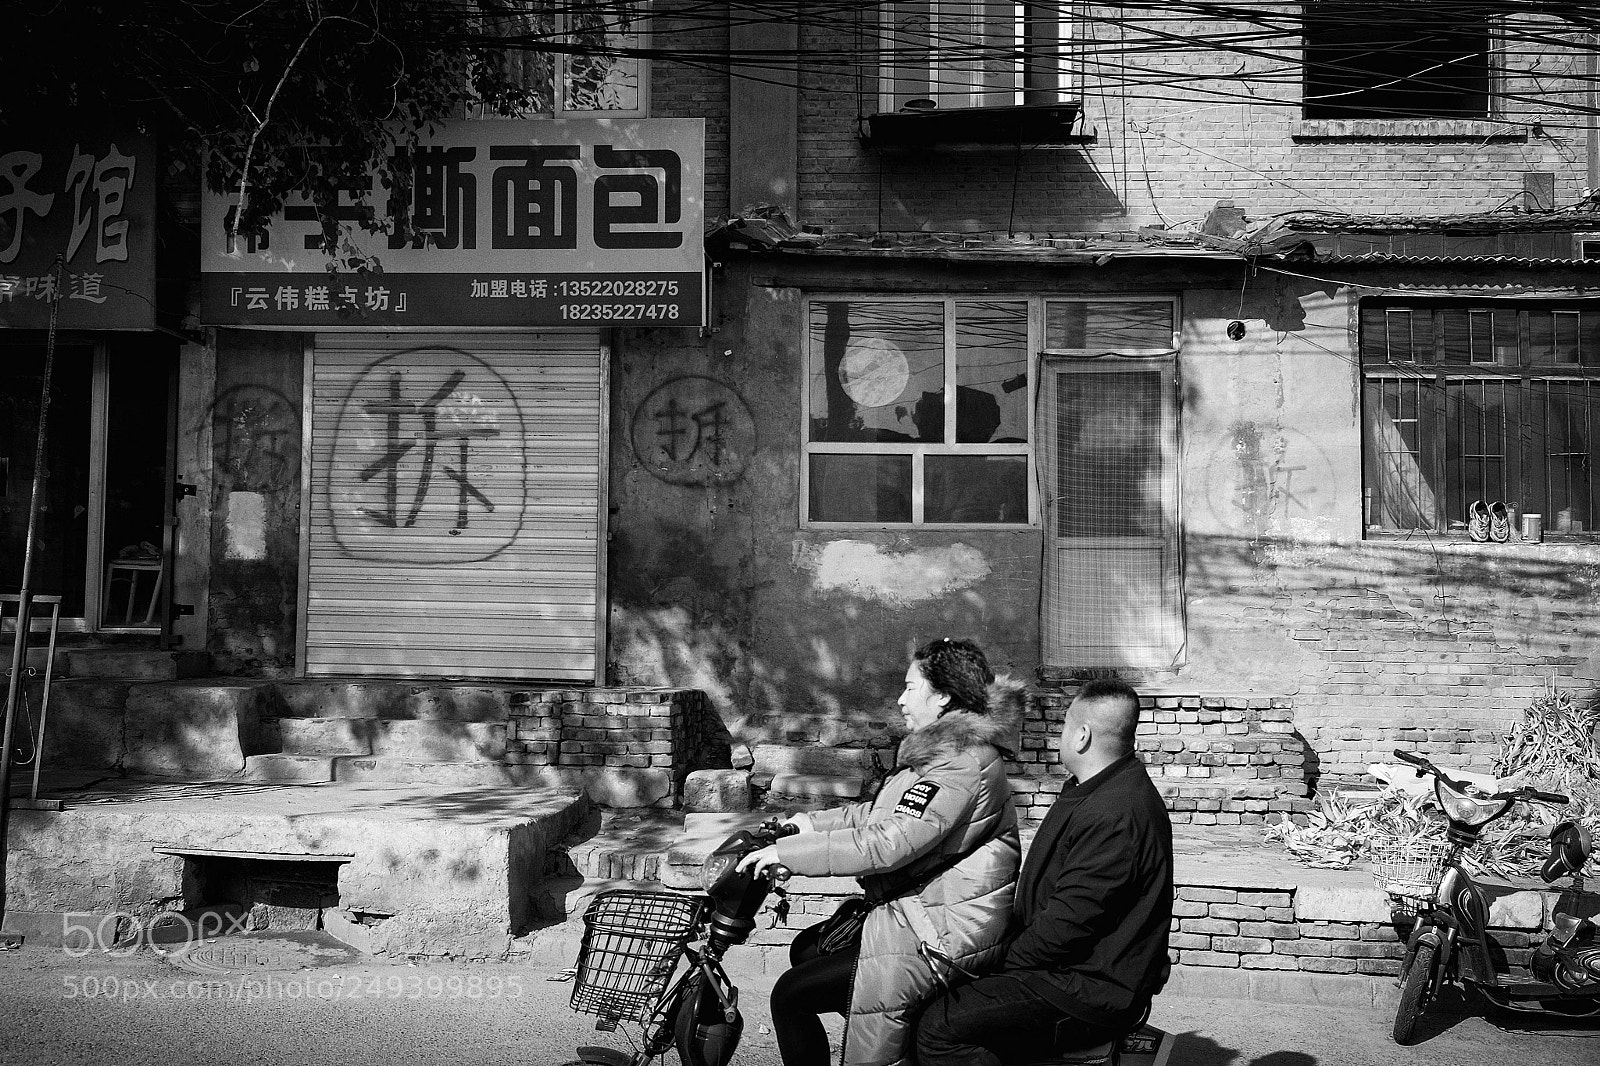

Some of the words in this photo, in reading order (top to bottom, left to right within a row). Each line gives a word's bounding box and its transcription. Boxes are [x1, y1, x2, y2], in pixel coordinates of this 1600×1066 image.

[559, 305, 679, 320] 18235227478
[361, 370, 500, 529] 拆
[904, 793, 927, 805] HOUR
[896, 804, 922, 817] CHAOS
